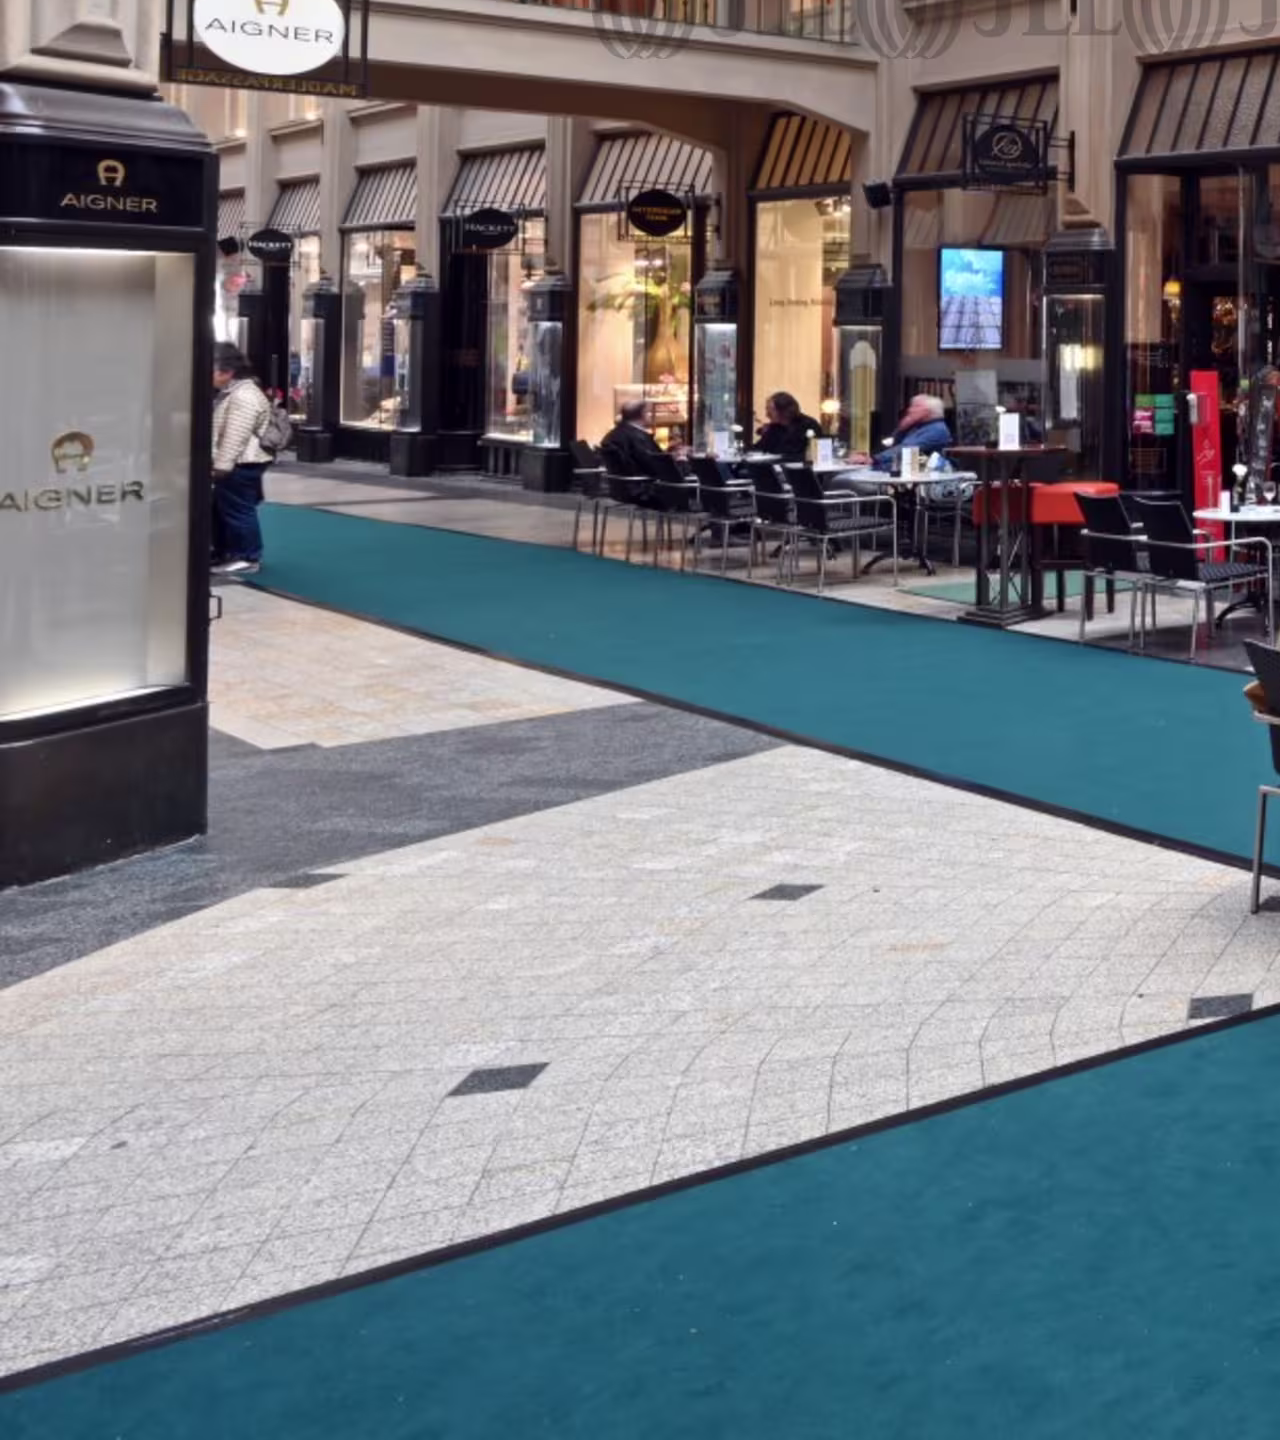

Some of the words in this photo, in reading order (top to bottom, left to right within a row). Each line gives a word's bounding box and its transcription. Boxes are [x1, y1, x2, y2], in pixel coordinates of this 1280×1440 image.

[205, 17, 334, 44] AIGNER
[60, 193, 158, 213] AIGNER
[464, 223, 515, 233] HACKETT
[248, 240, 293, 250] HACKETT
[0, 480, 145, 513] AIGNER
